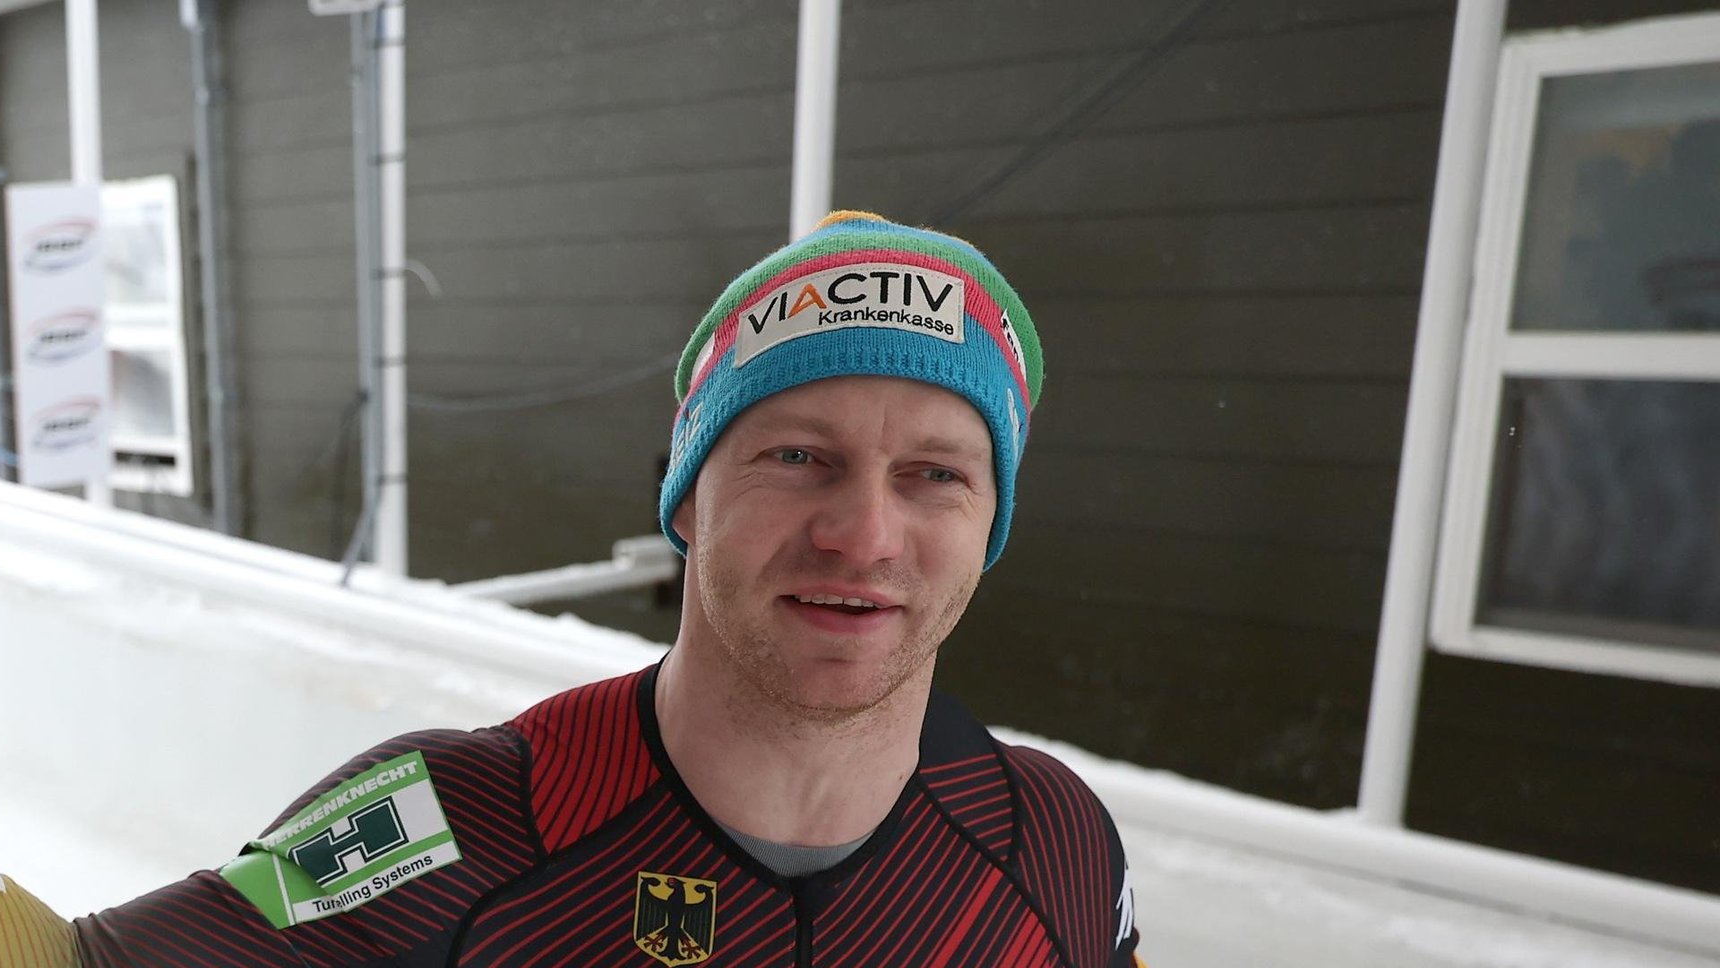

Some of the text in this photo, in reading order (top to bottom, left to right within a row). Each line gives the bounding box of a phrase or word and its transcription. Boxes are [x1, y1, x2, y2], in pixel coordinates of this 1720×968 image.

[747, 271, 954, 335] VIACTIV
[818, 308, 954, 336] Krankenkasse
[312, 854, 433, 912] Tulling Systems
